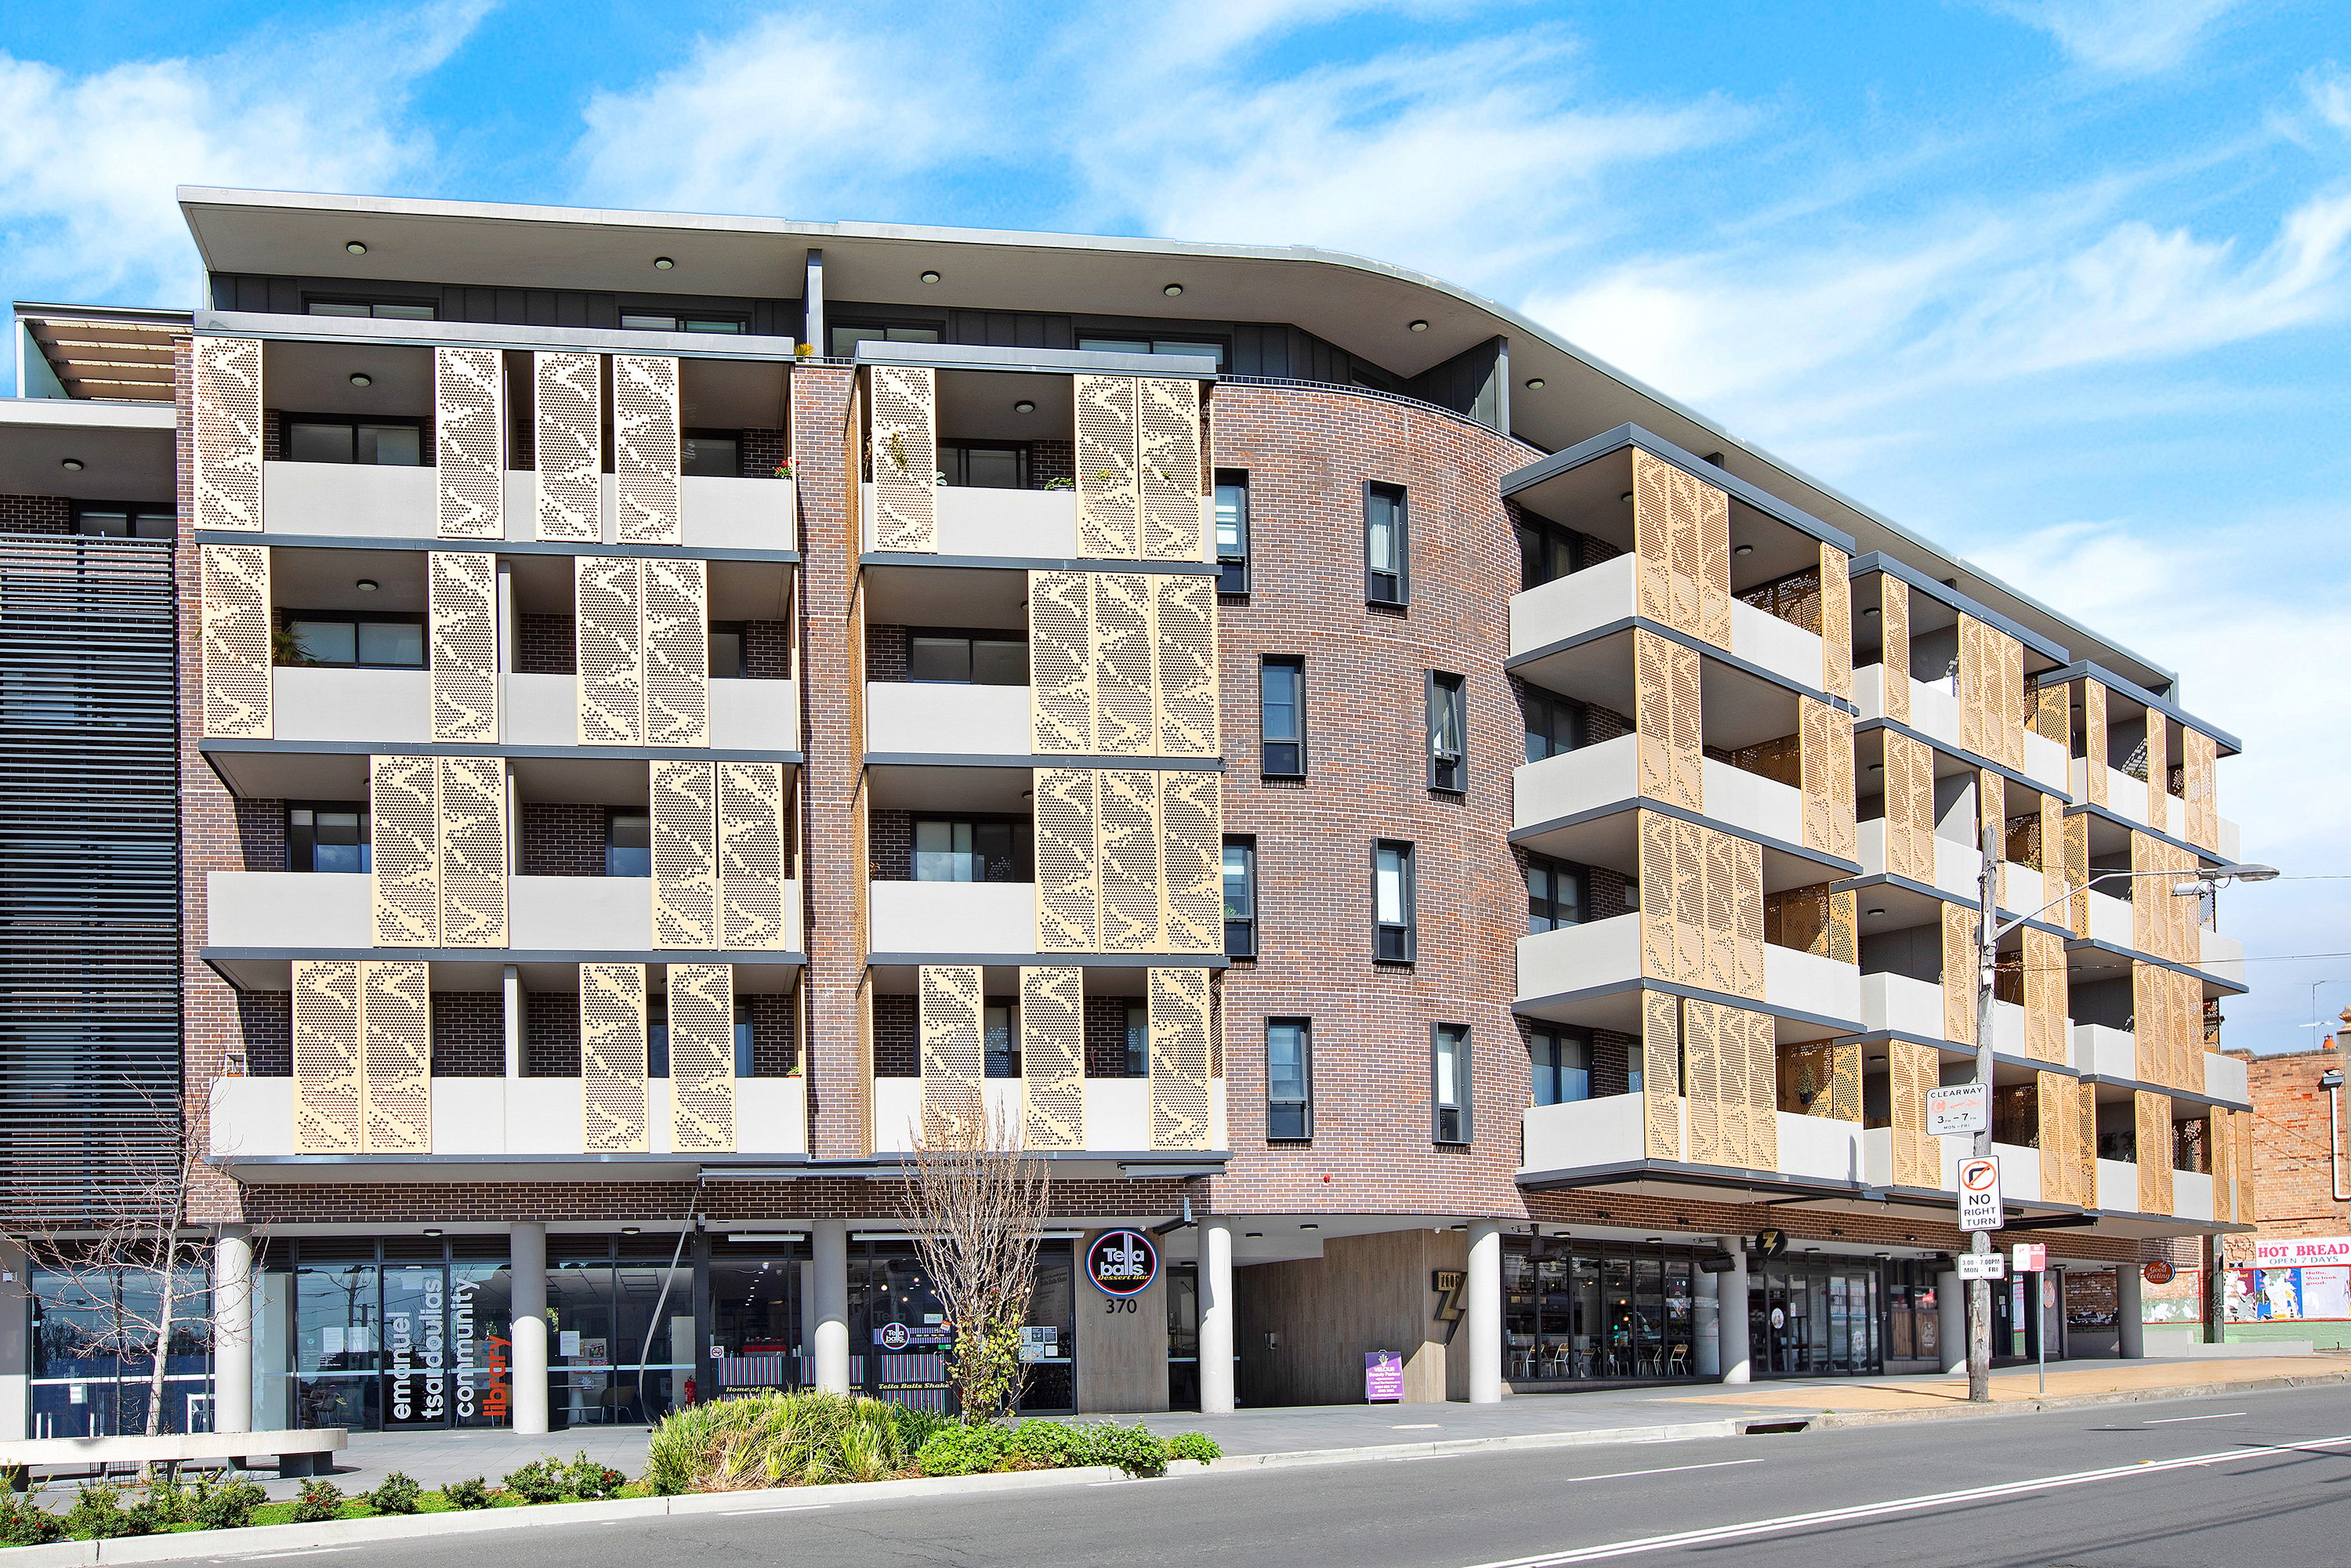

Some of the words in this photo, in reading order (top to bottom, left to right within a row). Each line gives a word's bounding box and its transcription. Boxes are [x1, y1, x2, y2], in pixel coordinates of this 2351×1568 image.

[1930, 1087, 1983, 1099] CLEARWAY
[1969, 1193, 1991, 1205] NO
[1964, 1207, 1996, 1216] RIGHT
[1965, 1218, 1996, 1226] TURN
[1103, 1232, 1144, 1262] Tella
[2258, 1246, 2288, 1258] HOT
[2296, 1244, 2349, 1256] BREAD
[1100, 1262, 1144, 1276] balls
[1441, 1274, 1460, 1287] ZEUS
[1106, 1298, 1137, 1313] 370
[418, 1280, 444, 1419] tsardoulias
[451, 1277, 480, 1418] community
[386, 1312, 411, 1419] emanuel
[482, 1334, 512, 1417] library
